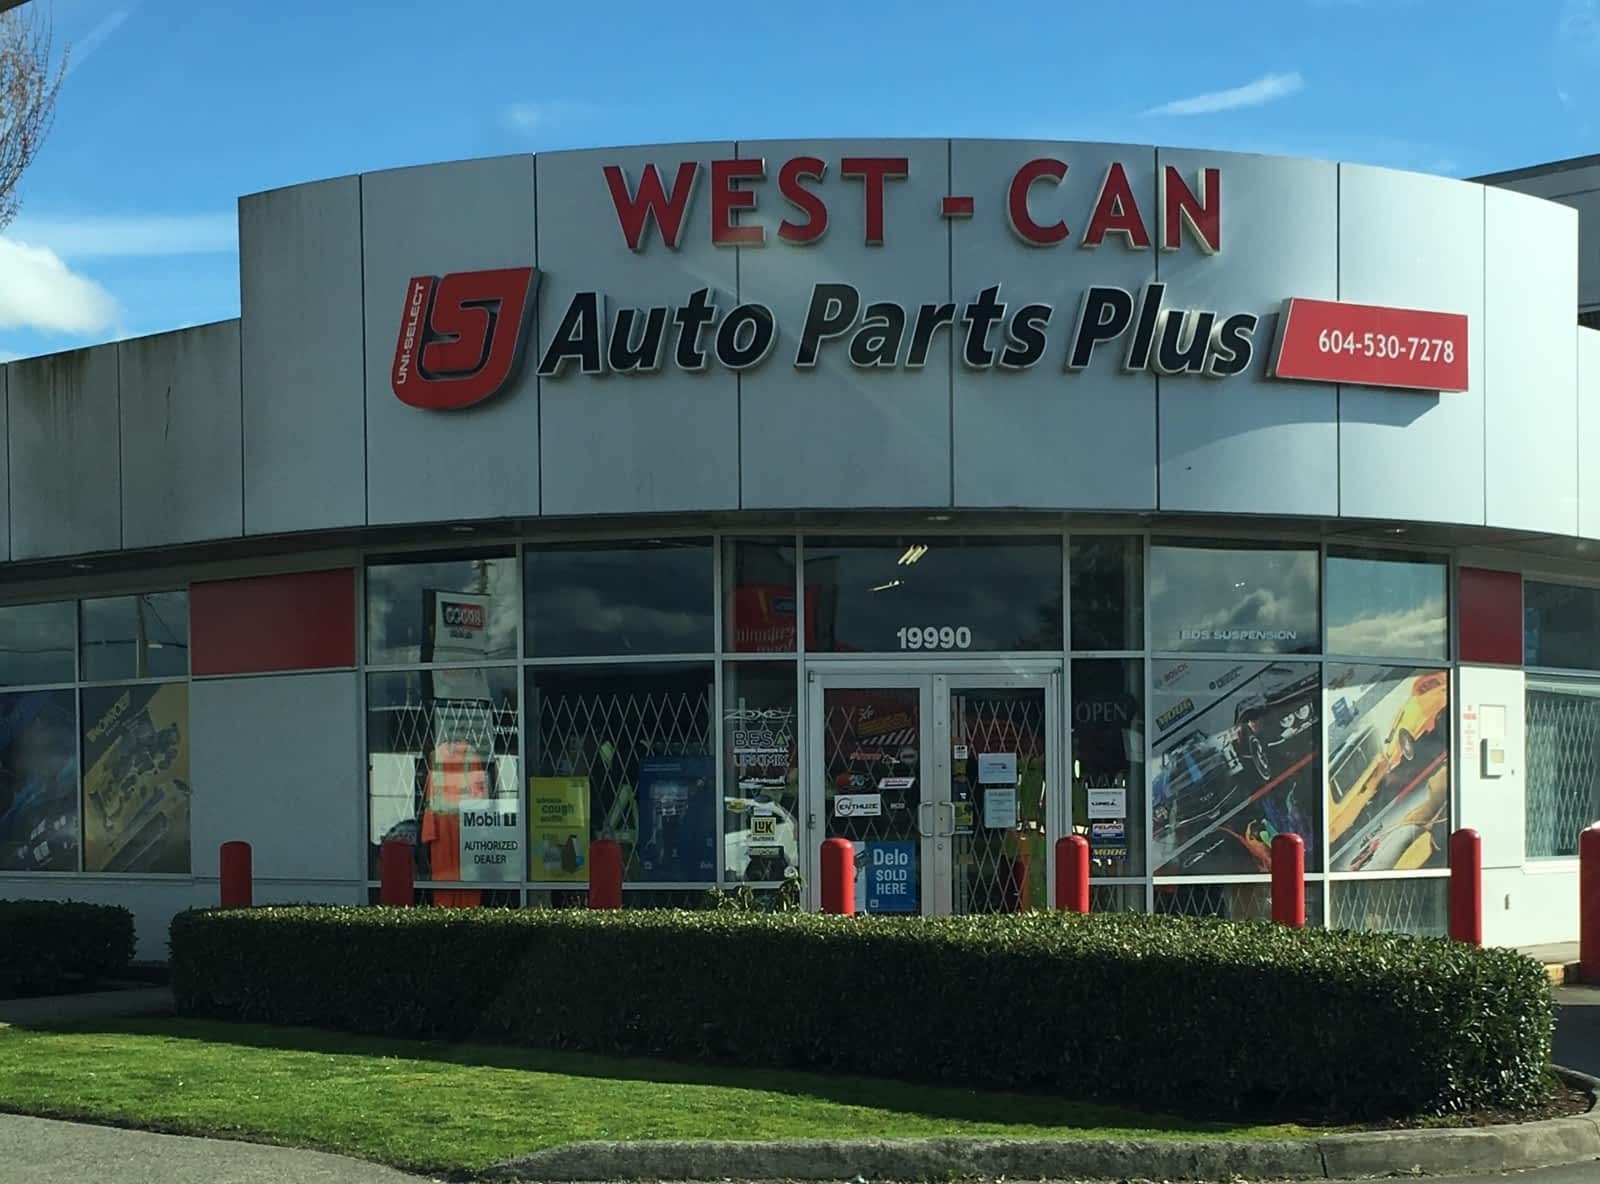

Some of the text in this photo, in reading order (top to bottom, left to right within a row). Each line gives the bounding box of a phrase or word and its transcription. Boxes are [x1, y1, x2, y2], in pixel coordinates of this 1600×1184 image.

[603, 156, 909, 252] WEST
[1007, 157, 1222, 255] CAN
[396, 281, 425, 385] UNI-SELECT
[537, 281, 1258, 378] Auto Parts Plus
[1318, 327, 1456, 366] 604-530-7278
[896, 626, 972, 650] 19990
[1213, 629, 1297, 641] SUSPENSION
[1075, 702, 1128, 722] OPEN
[733, 730, 789, 748] BESA
[463, 811, 501, 827] Mobil
[464, 840, 518, 851] AUTHORIZED
[473, 854, 507, 865] DEALER
[873, 848, 908, 866] Delo
[876, 868, 907, 882] SOLD
[876, 882, 907, 895] HERE
